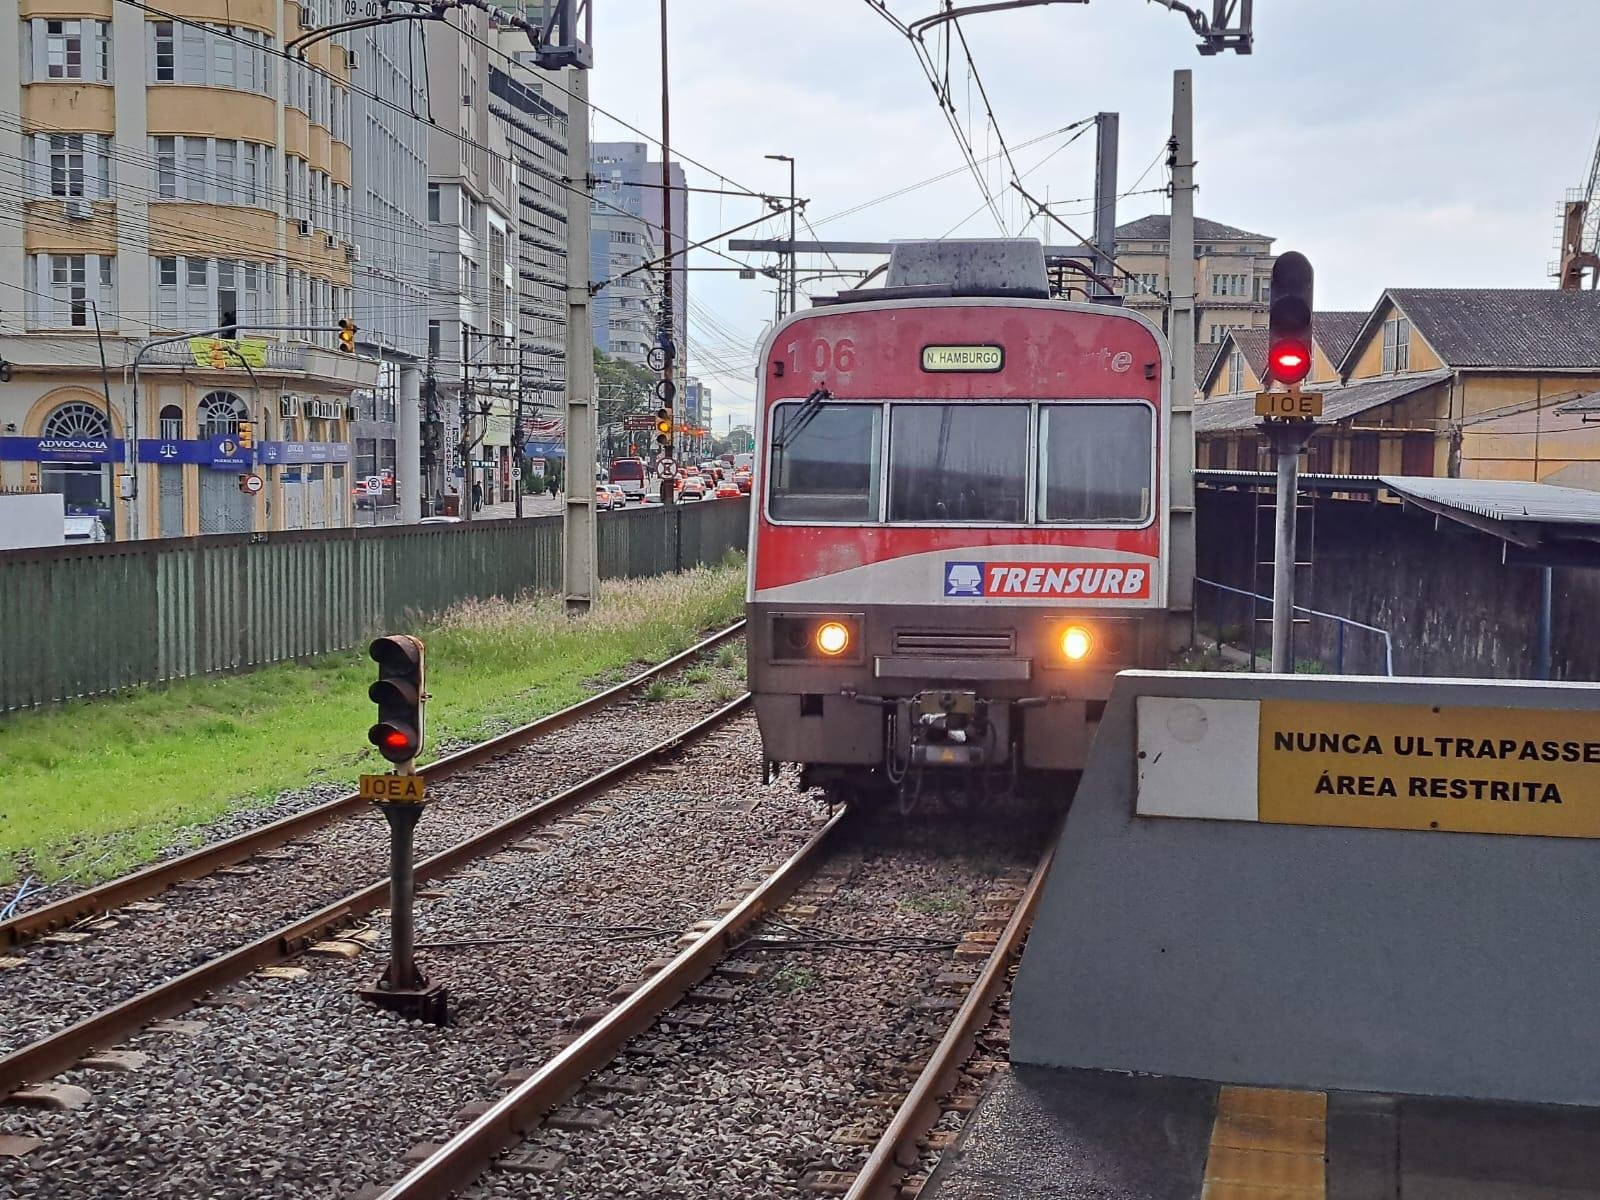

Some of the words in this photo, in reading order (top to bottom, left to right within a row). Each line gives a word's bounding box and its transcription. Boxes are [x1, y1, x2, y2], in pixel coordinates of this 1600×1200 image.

[787, 337, 856, 373] 106
[927, 352, 937, 364] N.
[939, 352, 999, 364] HAMBURGO
[38, 440, 108, 449] ADVOCACIA
[989, 567, 1146, 594] TRENSURB
[1274, 731, 1383, 755] NUNCA
[1394, 735, 1600, 763] ULTRAPASSE
[1315, 769, 1397, 797] ÁREA
[1408, 778, 1563, 804] RESTRITA
